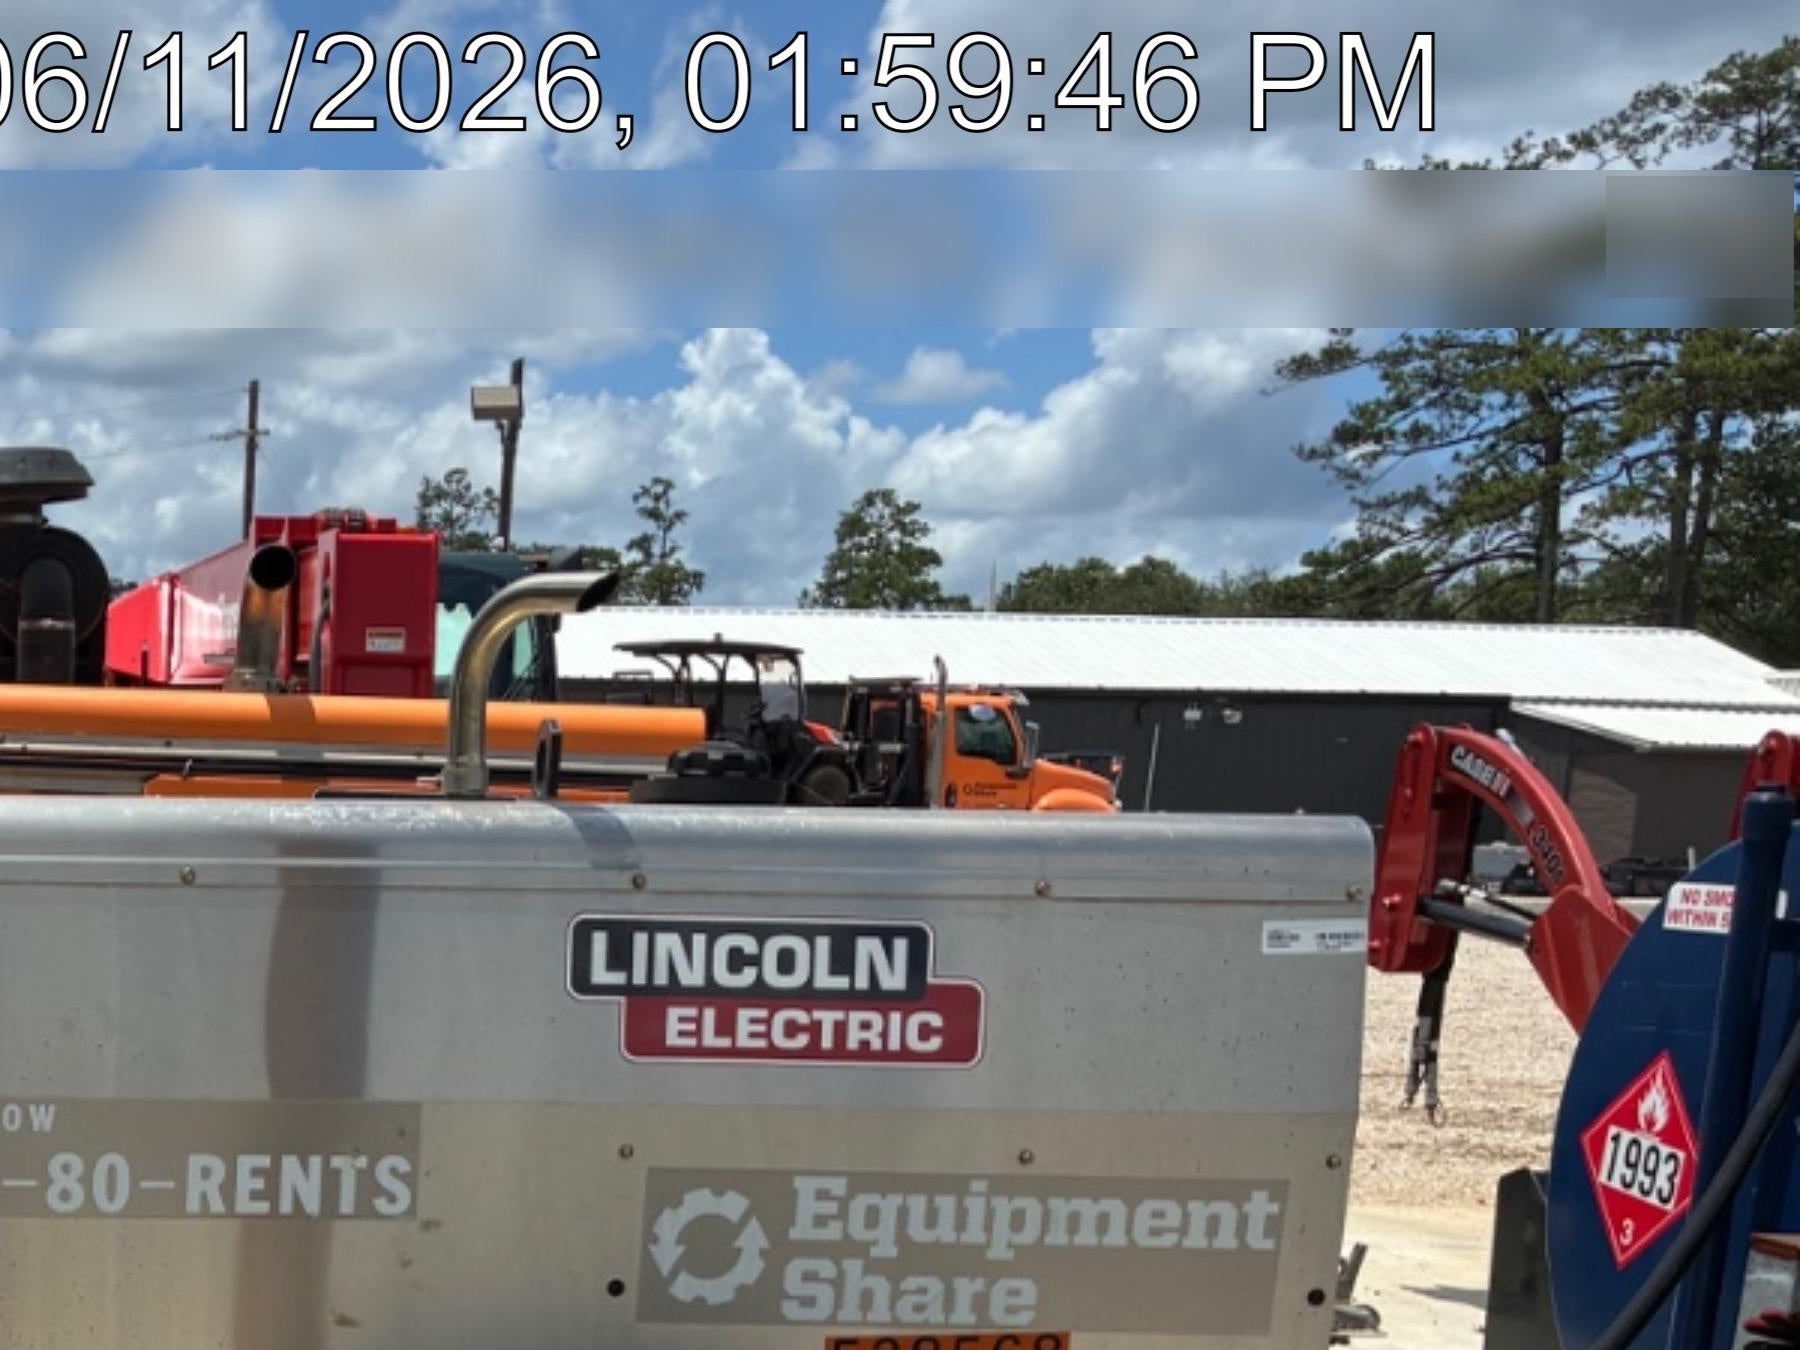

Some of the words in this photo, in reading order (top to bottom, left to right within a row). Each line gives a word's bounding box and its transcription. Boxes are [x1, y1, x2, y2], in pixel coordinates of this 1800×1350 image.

[1667, 908, 1717, 928] WITHIN
[1681, 889, 1701, 905] NO
[590, 930, 908, 991] LINCOLN
[665, 1006, 944, 1052] ELECTRIC
[1608, 1132, 1679, 1204] 1993
[788, 1175, 1280, 1261] Equipment
[1619, 1217, 1635, 1246] 3
[781, 1257, 1039, 1326] Share
